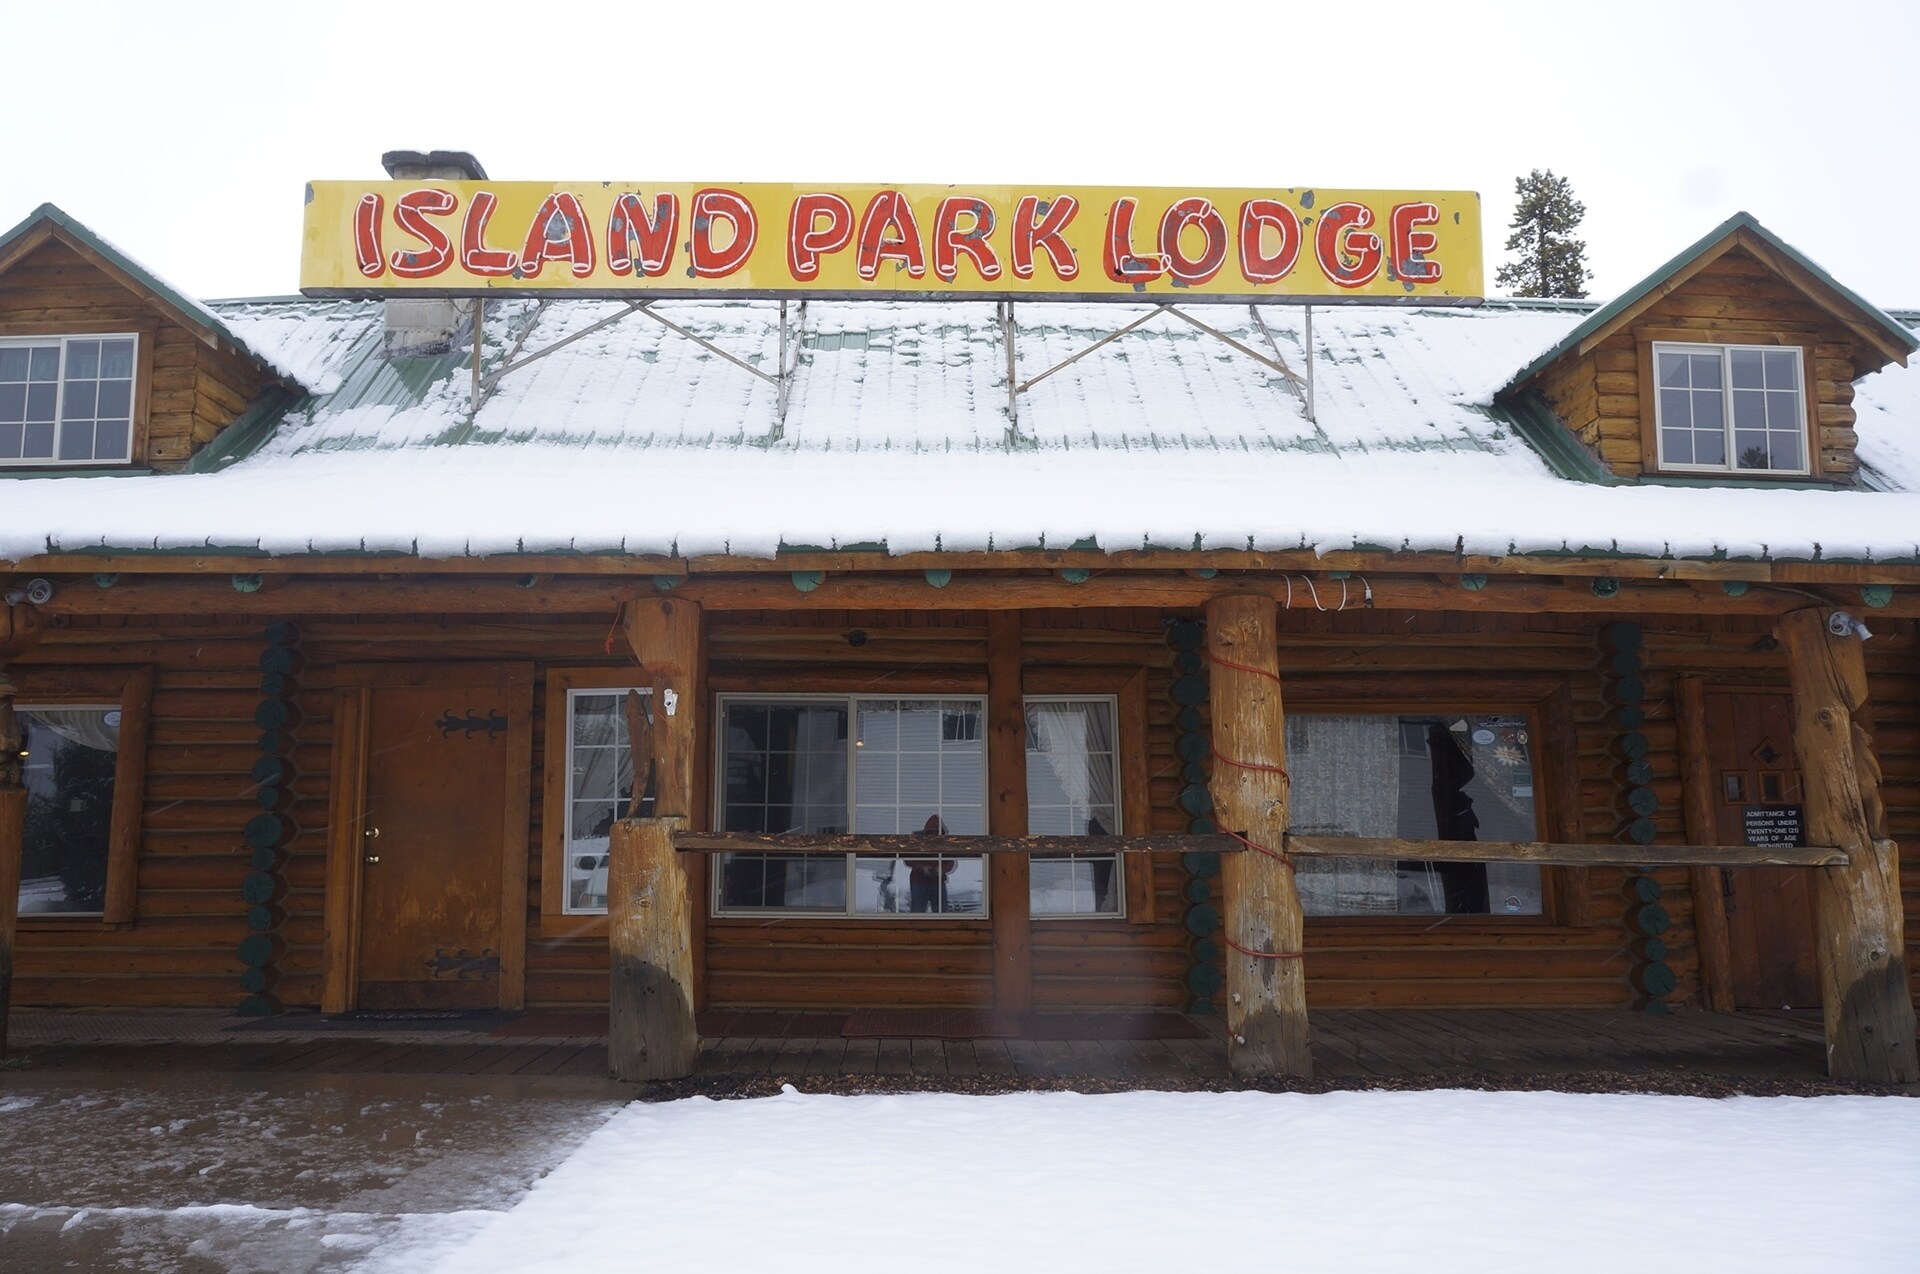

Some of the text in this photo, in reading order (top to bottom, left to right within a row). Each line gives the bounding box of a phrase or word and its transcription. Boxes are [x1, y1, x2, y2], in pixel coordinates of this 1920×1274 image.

[353, 188, 1442, 288] ISLAND PARK LODGE
